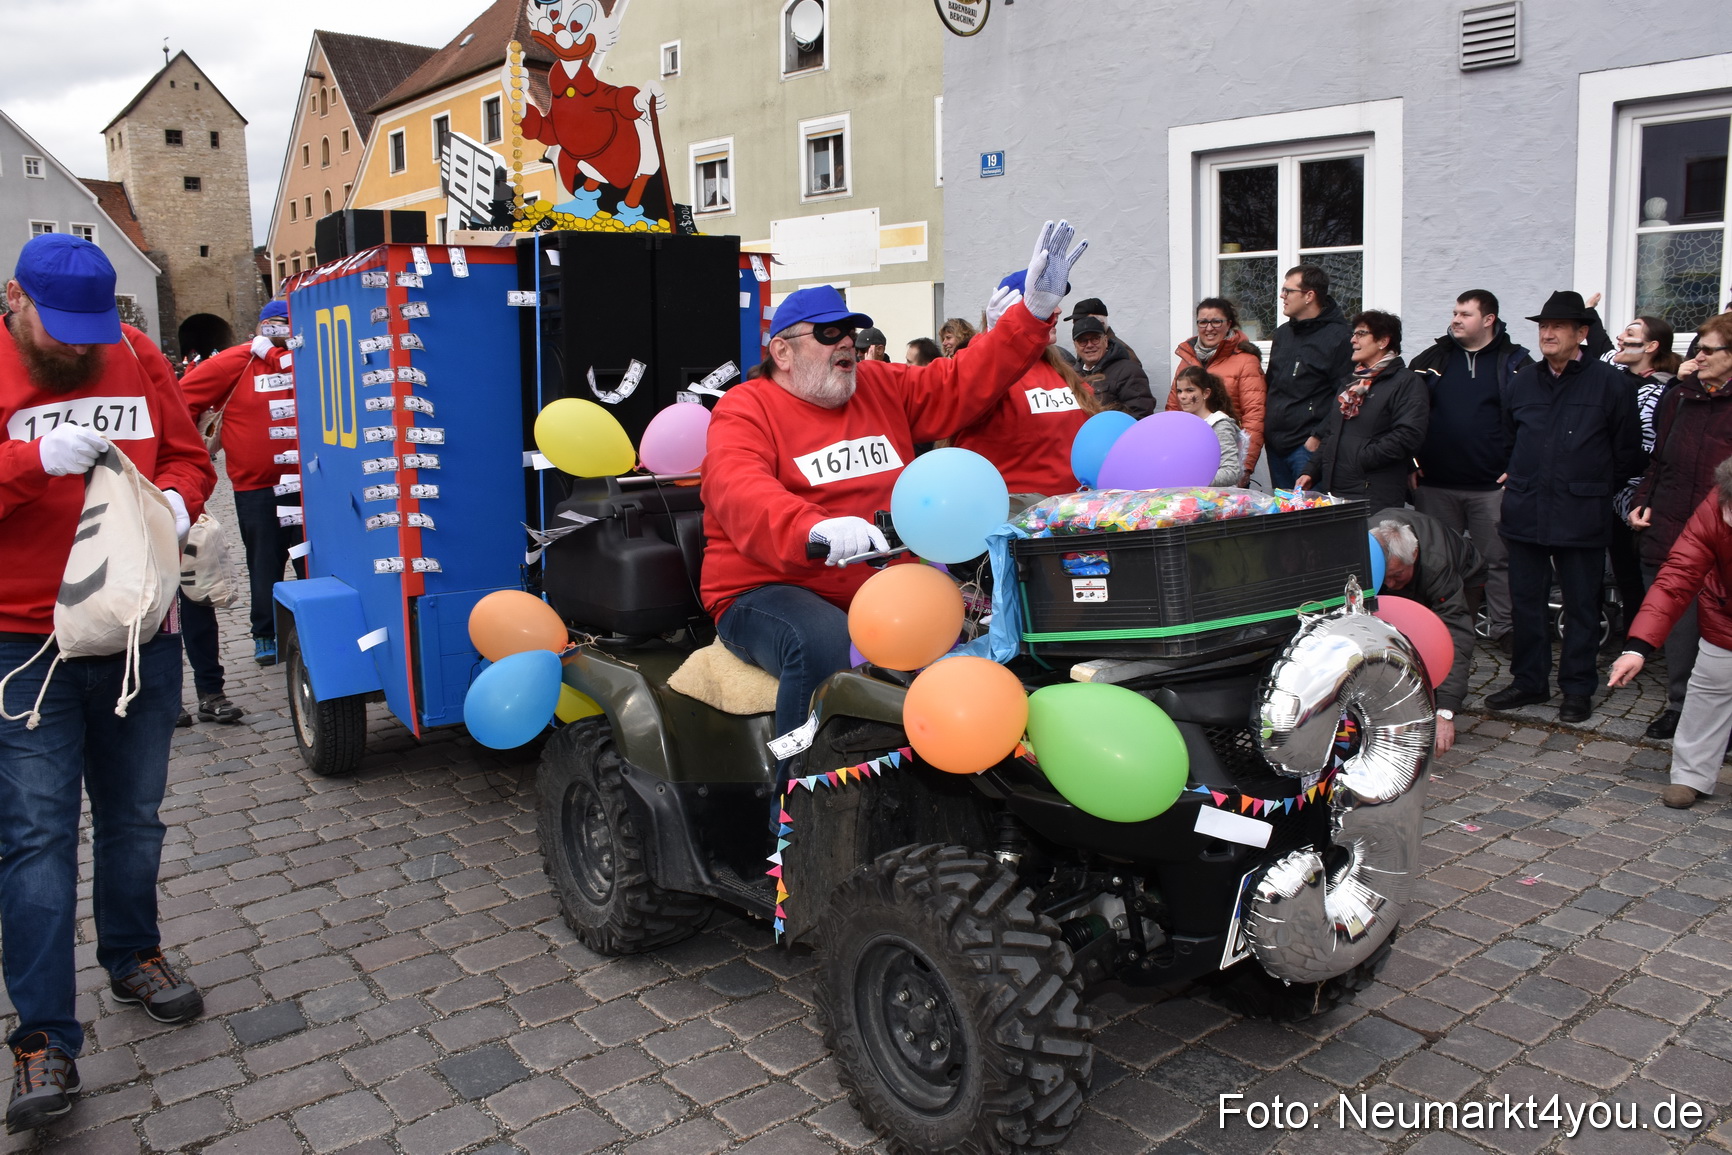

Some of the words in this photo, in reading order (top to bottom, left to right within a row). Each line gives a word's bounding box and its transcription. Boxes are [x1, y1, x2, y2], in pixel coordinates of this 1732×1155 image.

[949, 11, 975, 27] BERCHING
[987, 154, 997, 167] 19
[1031, 391, 1075, 409] 176-6
